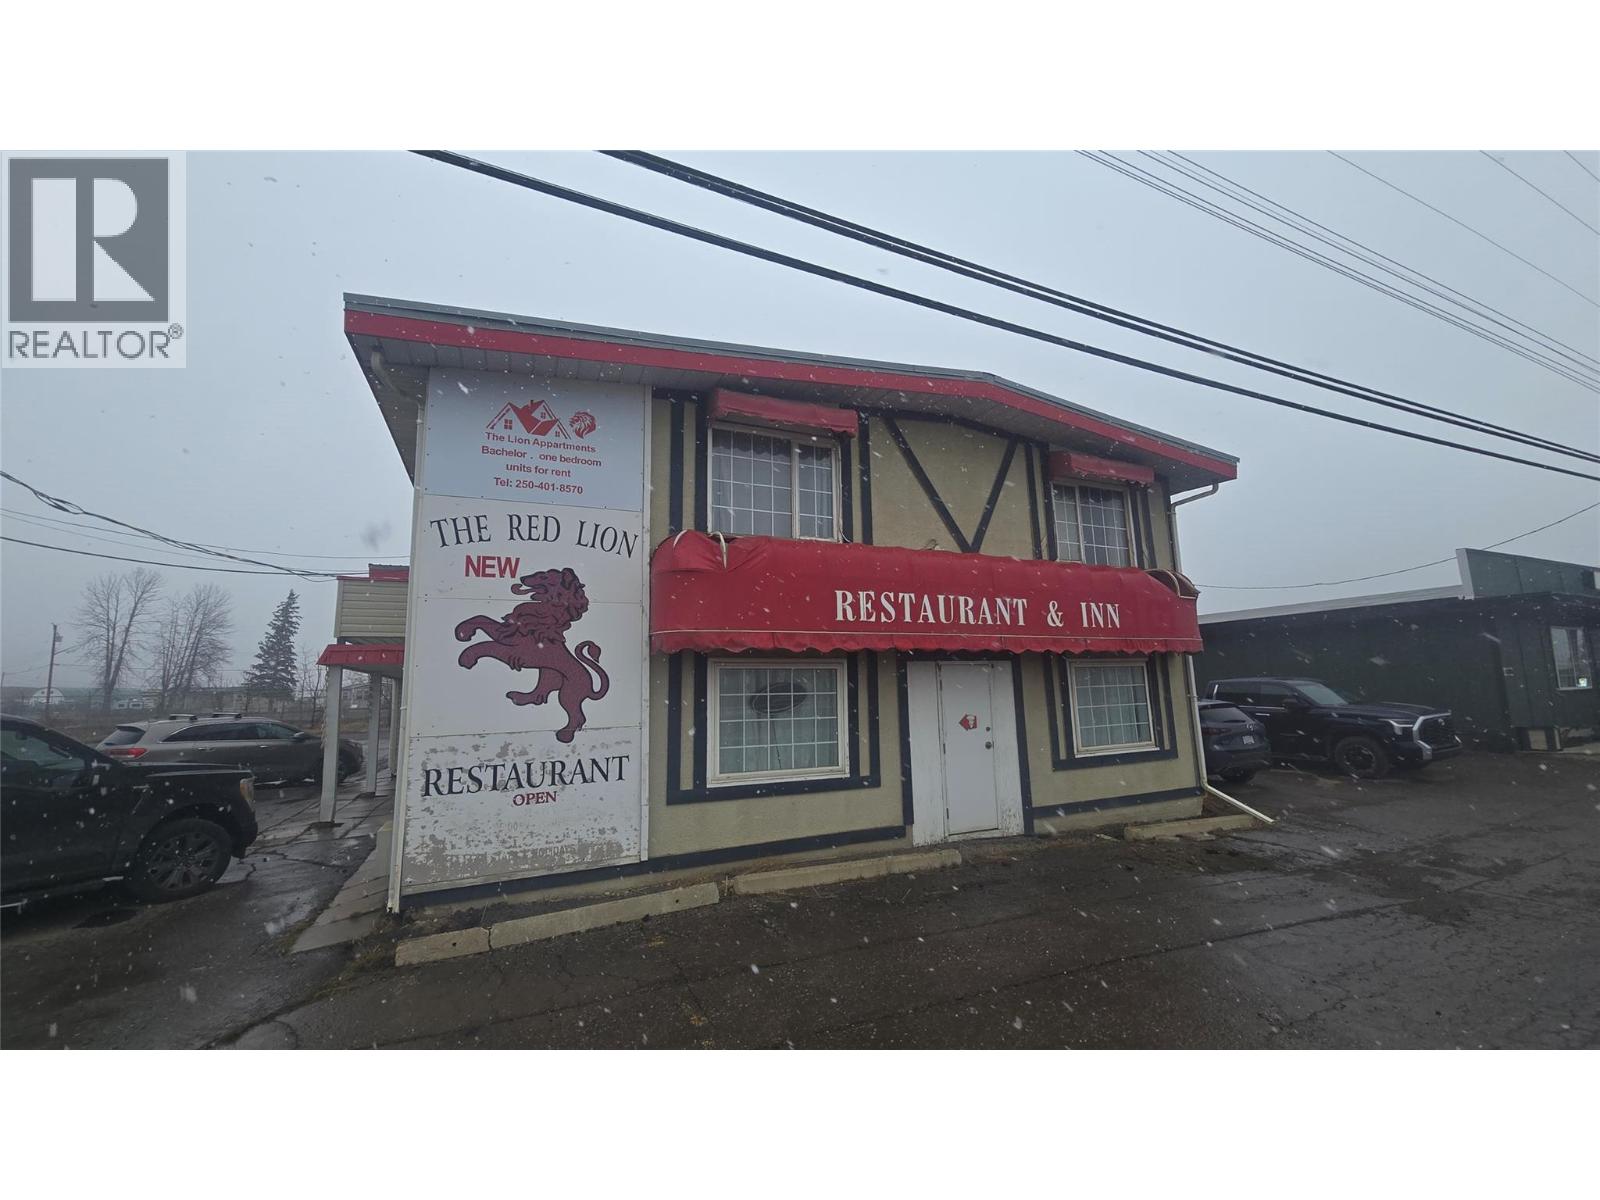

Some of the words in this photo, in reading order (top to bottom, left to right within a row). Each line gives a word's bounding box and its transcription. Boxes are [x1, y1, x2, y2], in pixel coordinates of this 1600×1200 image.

[484, 431, 505, 442] The
[508, 434, 531, 445] Lion
[532, 438, 597, 453] Appartments
[481, 445, 527, 459] Bachelor
[538, 452, 557, 462] one
[559, 454, 602, 467] bedroom
[506, 463, 532, 473] units
[534, 465, 548, 475] for
[551, 468, 571, 478] rent
[494, 477, 513, 488] Tel:
[515, 479, 584, 495] 250-401-8570
[430, 514, 491, 548] THE
[507, 513, 561, 543] RED
[575, 519, 639, 559] LION
[464, 554, 520, 579] NEW
[834, 589, 1028, 627] RESTAURANT
[1046, 600, 1064, 628] &
[1079, 601, 1120, 629] INN
[421, 755, 630, 798] RESTAURANT
[512, 790, 557, 807] OPEN
